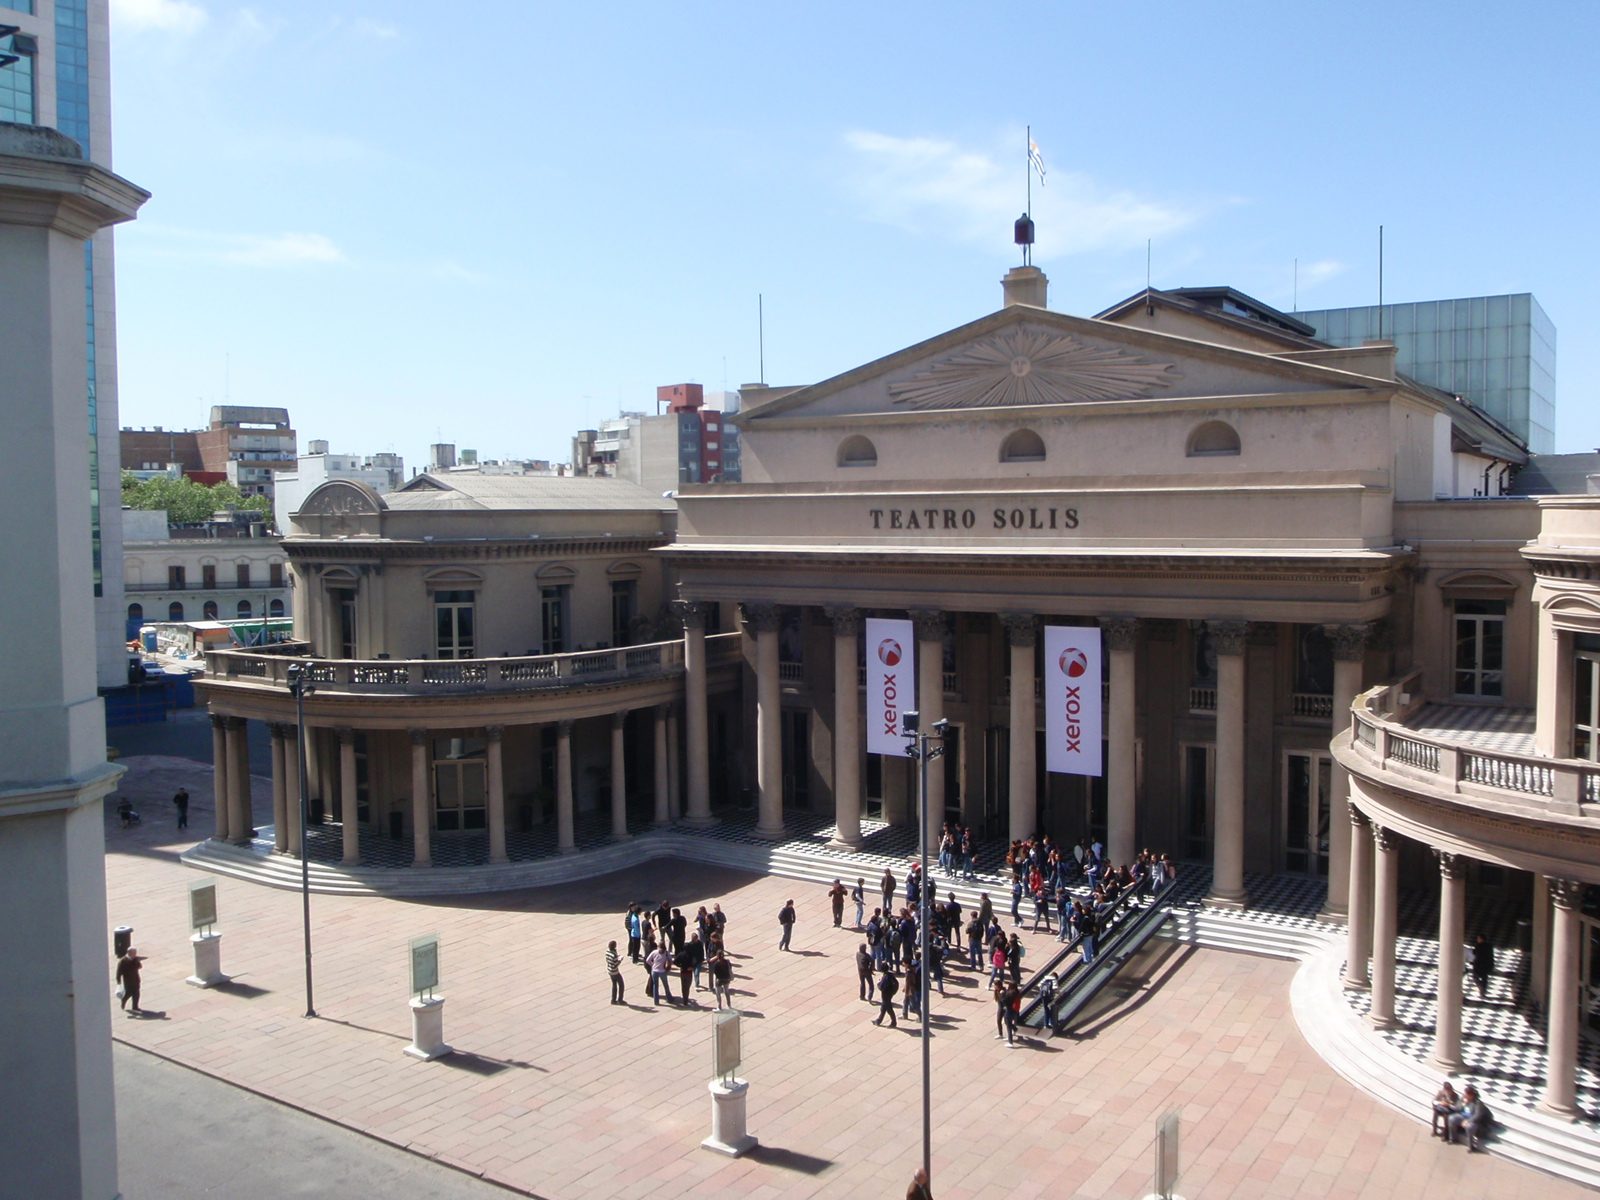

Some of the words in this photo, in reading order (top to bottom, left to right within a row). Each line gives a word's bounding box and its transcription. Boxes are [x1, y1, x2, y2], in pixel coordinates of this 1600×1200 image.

[869, 509, 976, 530] TEATRO
[993, 508, 1080, 530] SOLIS
[883, 674, 897, 736] xerox
[1066, 686, 1081, 754] xerox
